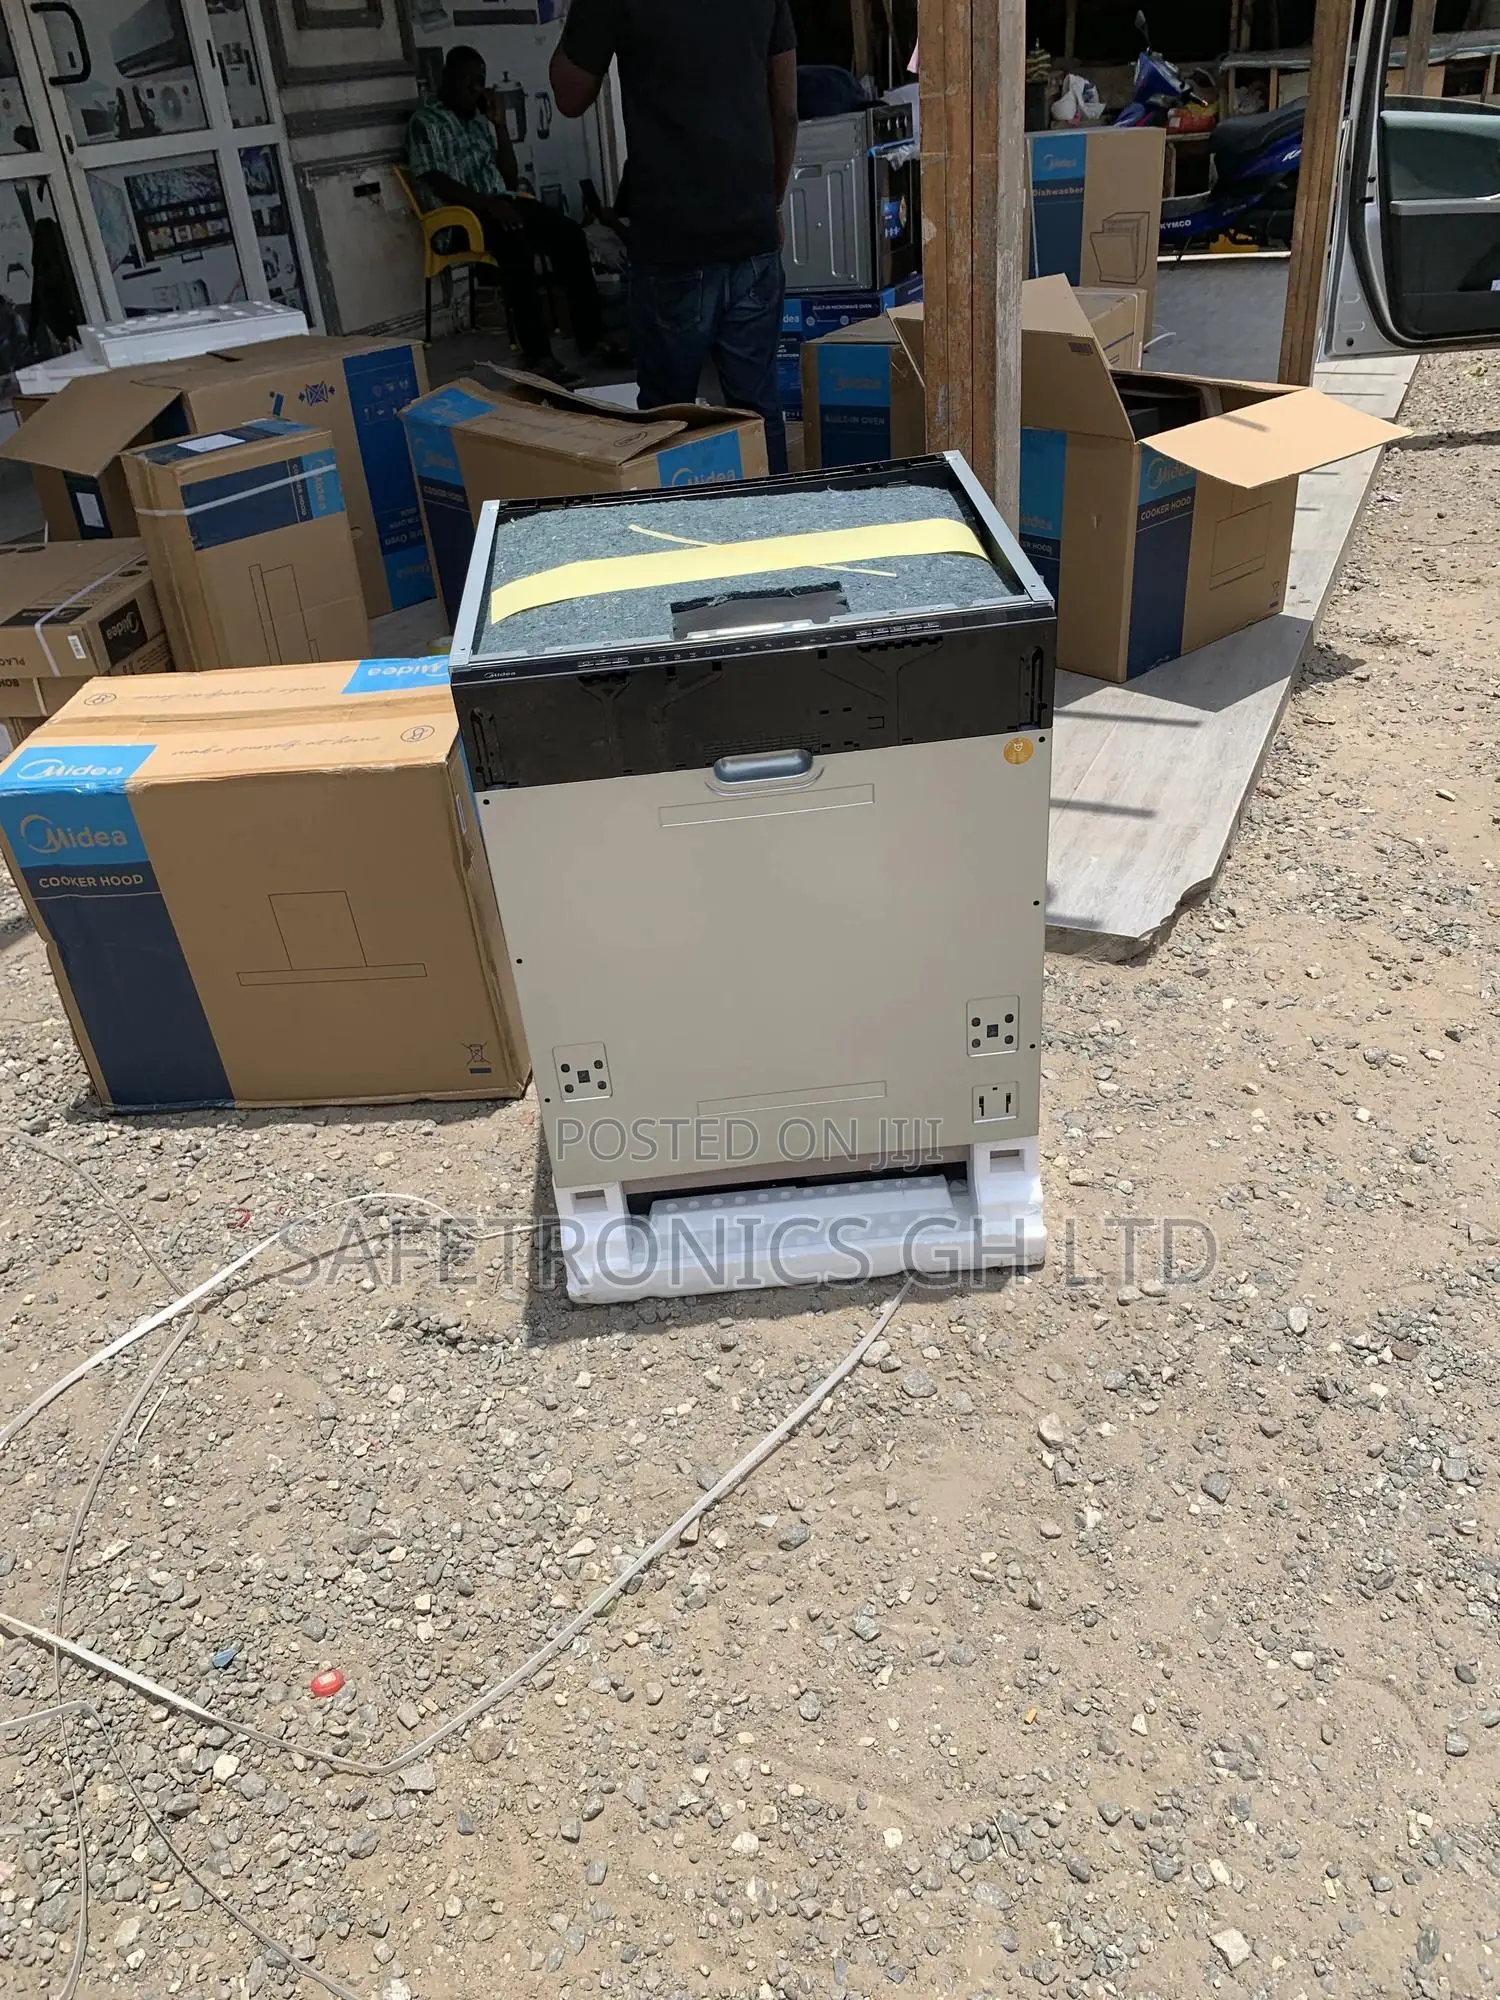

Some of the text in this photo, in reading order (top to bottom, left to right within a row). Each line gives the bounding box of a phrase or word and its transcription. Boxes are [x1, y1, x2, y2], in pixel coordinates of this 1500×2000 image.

[1032, 187, 1084, 197] Dishwasher
[783, 314, 800, 324] dea
[1140, 496, 1192, 521] COOKER HOOD
[484, 671, 517, 679] Midea
[17, 759, 124, 780] Midea
[20, 814, 128, 854] Midea
[39, 874, 144, 889] COOKER HOOD
